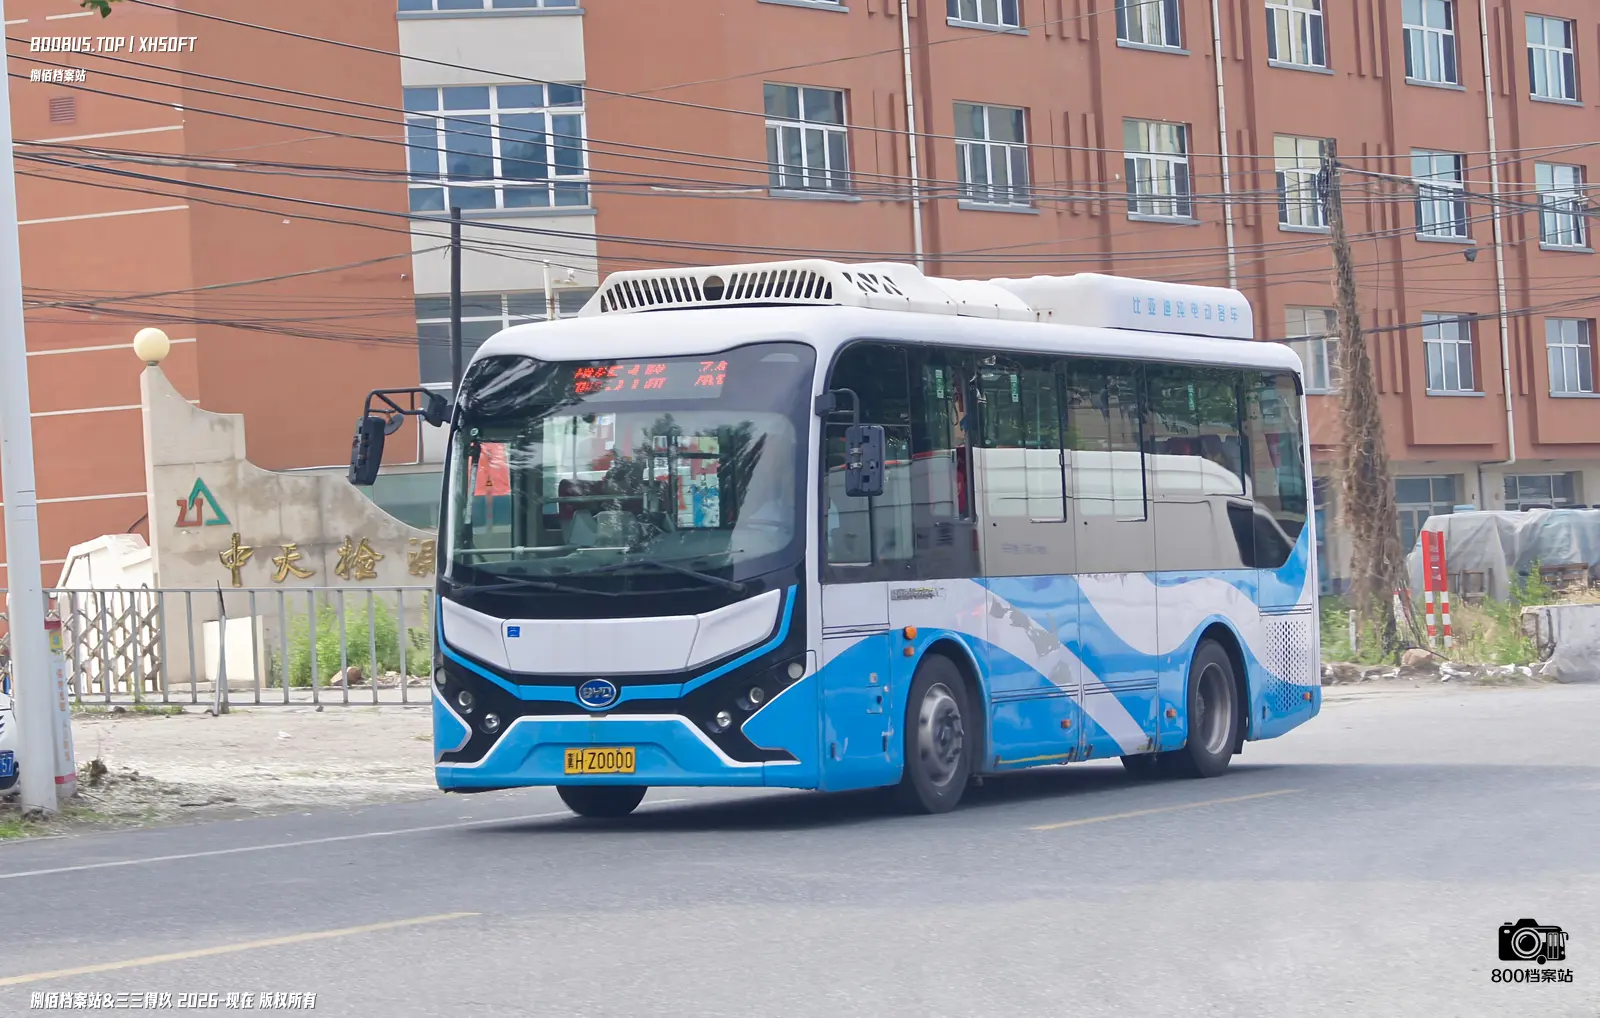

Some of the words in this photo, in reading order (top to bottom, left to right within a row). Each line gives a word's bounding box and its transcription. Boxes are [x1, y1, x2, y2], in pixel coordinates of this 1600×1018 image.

[1132, 295, 1239, 322] 比亚迪纯电动客车
